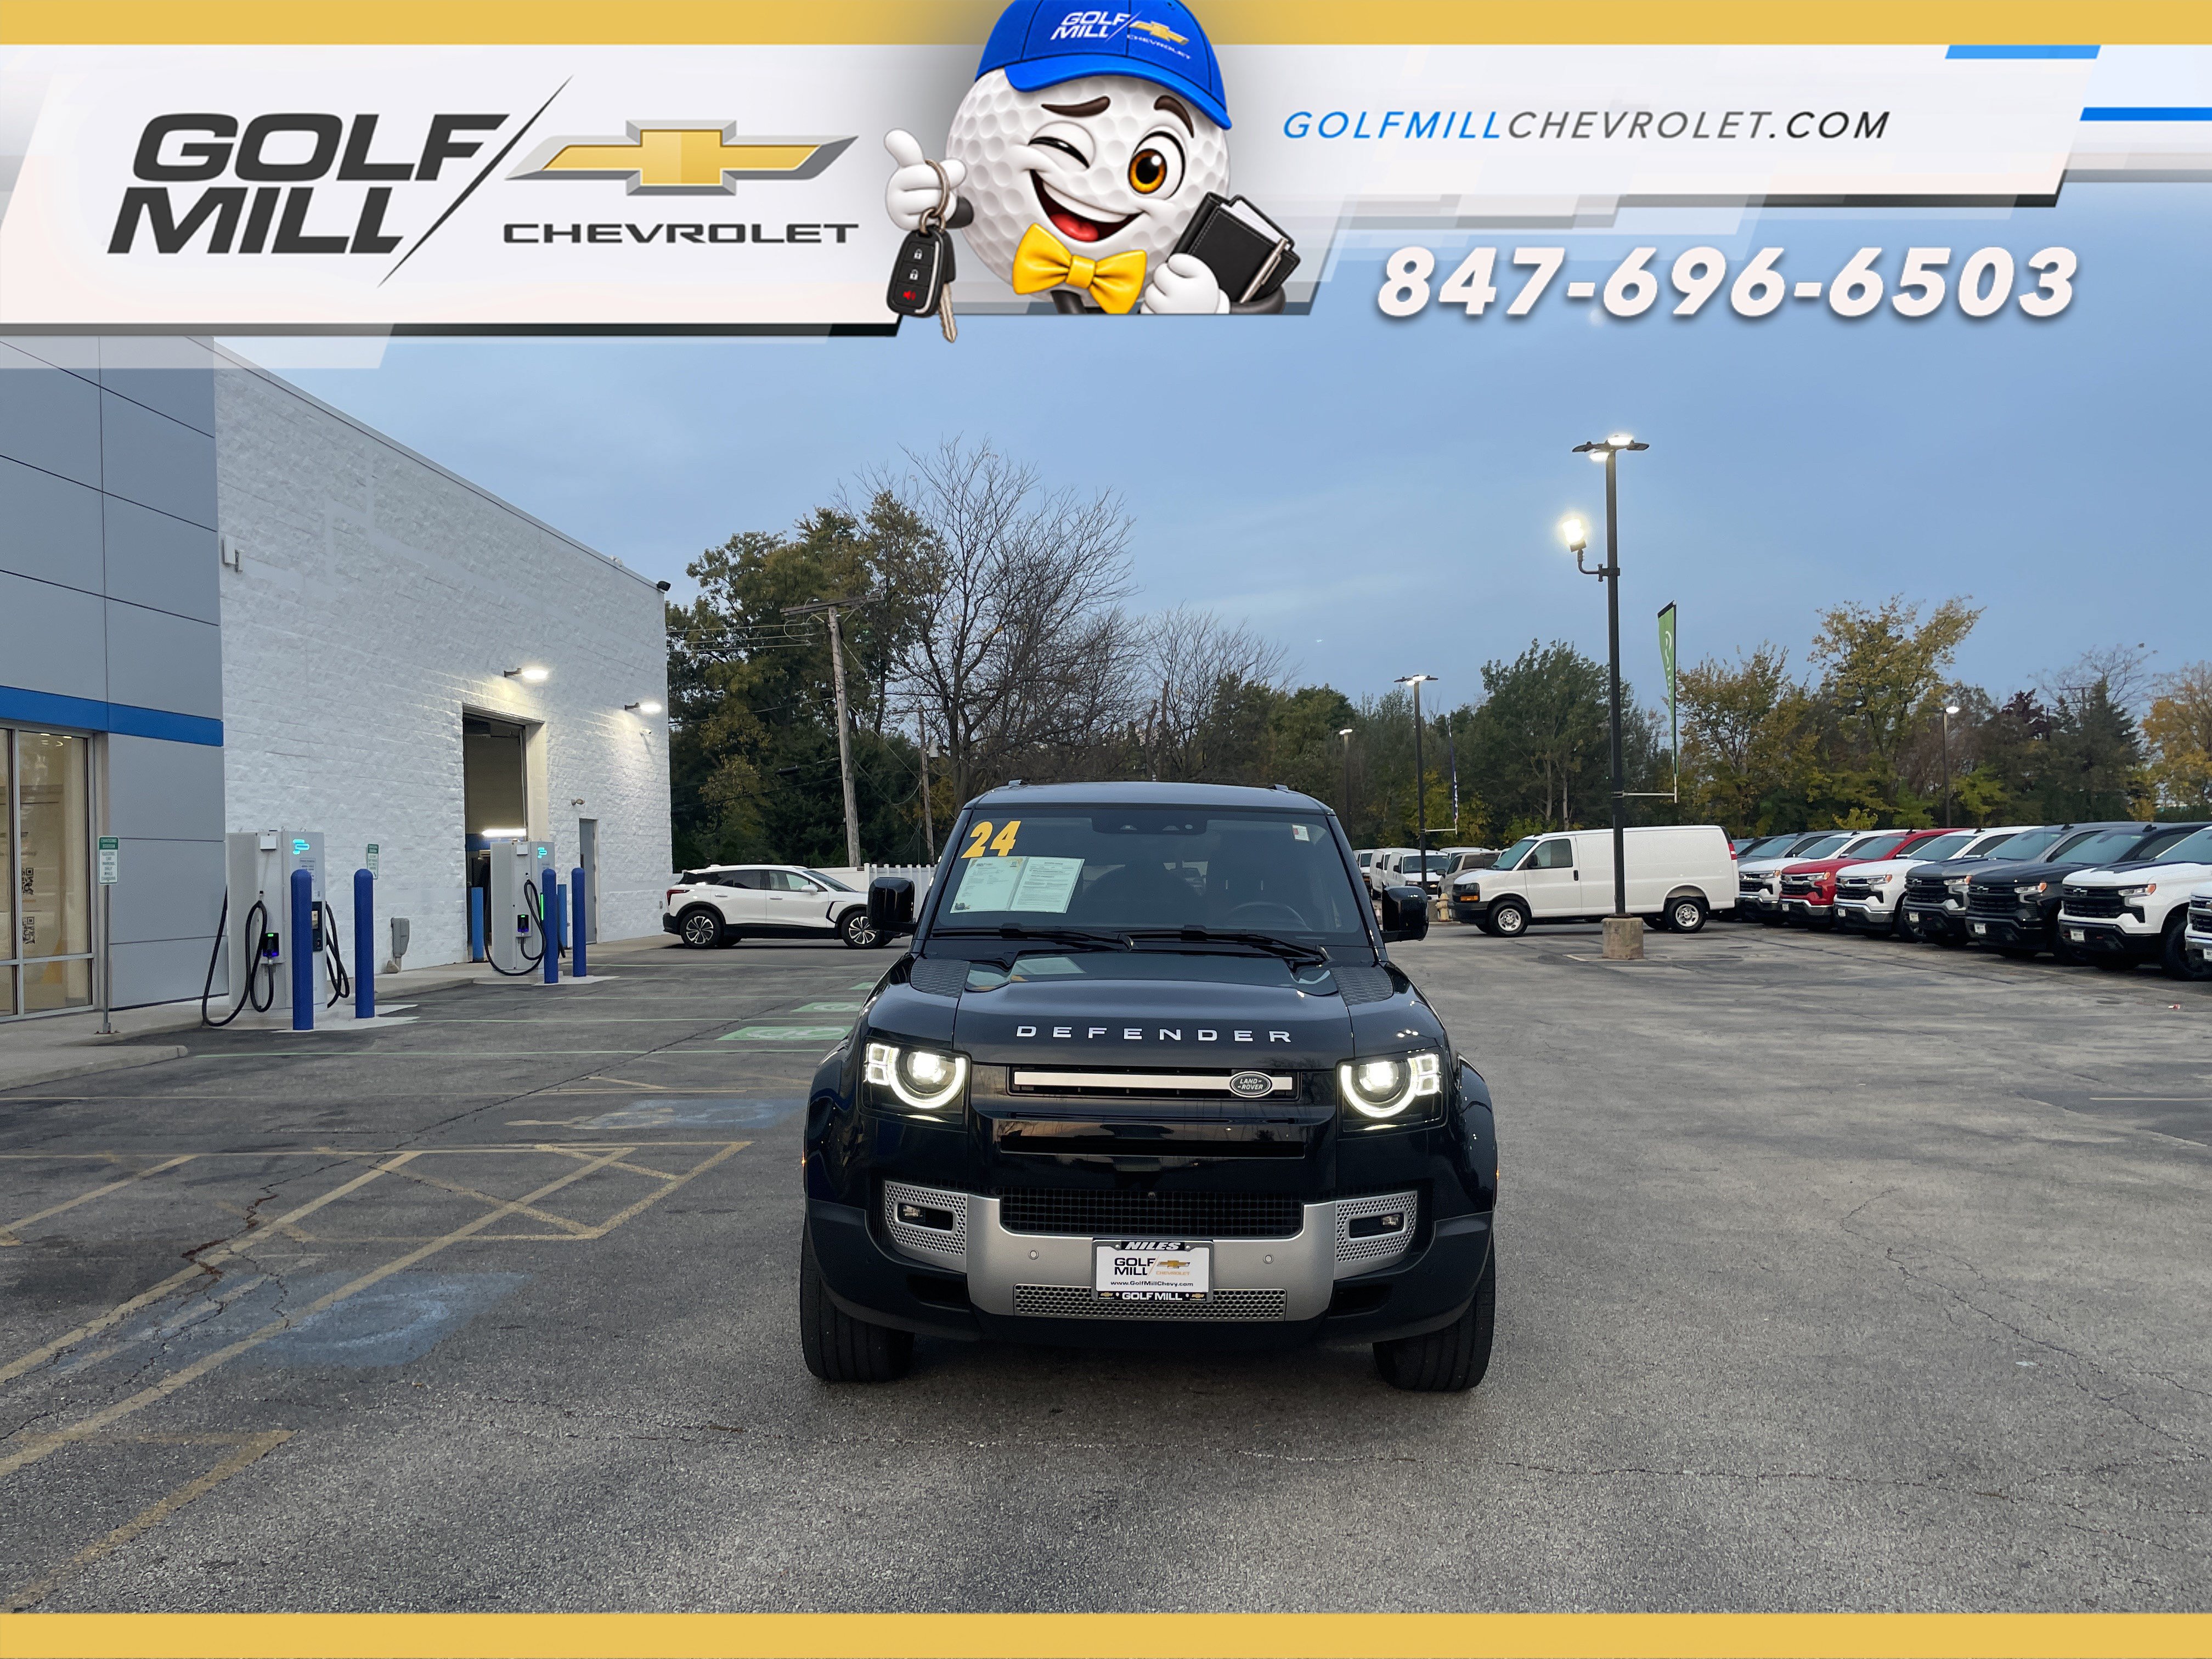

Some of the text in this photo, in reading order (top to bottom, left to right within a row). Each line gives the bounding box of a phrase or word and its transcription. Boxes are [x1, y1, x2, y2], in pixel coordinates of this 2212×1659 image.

[961, 821, 1021, 859] 24
[1016, 1025, 1291, 1042] DEFENDER
[1125, 1242, 1181, 1250] NILES
[1114, 1257, 1156, 1267] GOLF
[1114, 1267, 1148, 1276] MILL
[1122, 1292, 1182, 1301] GOLF MILL
